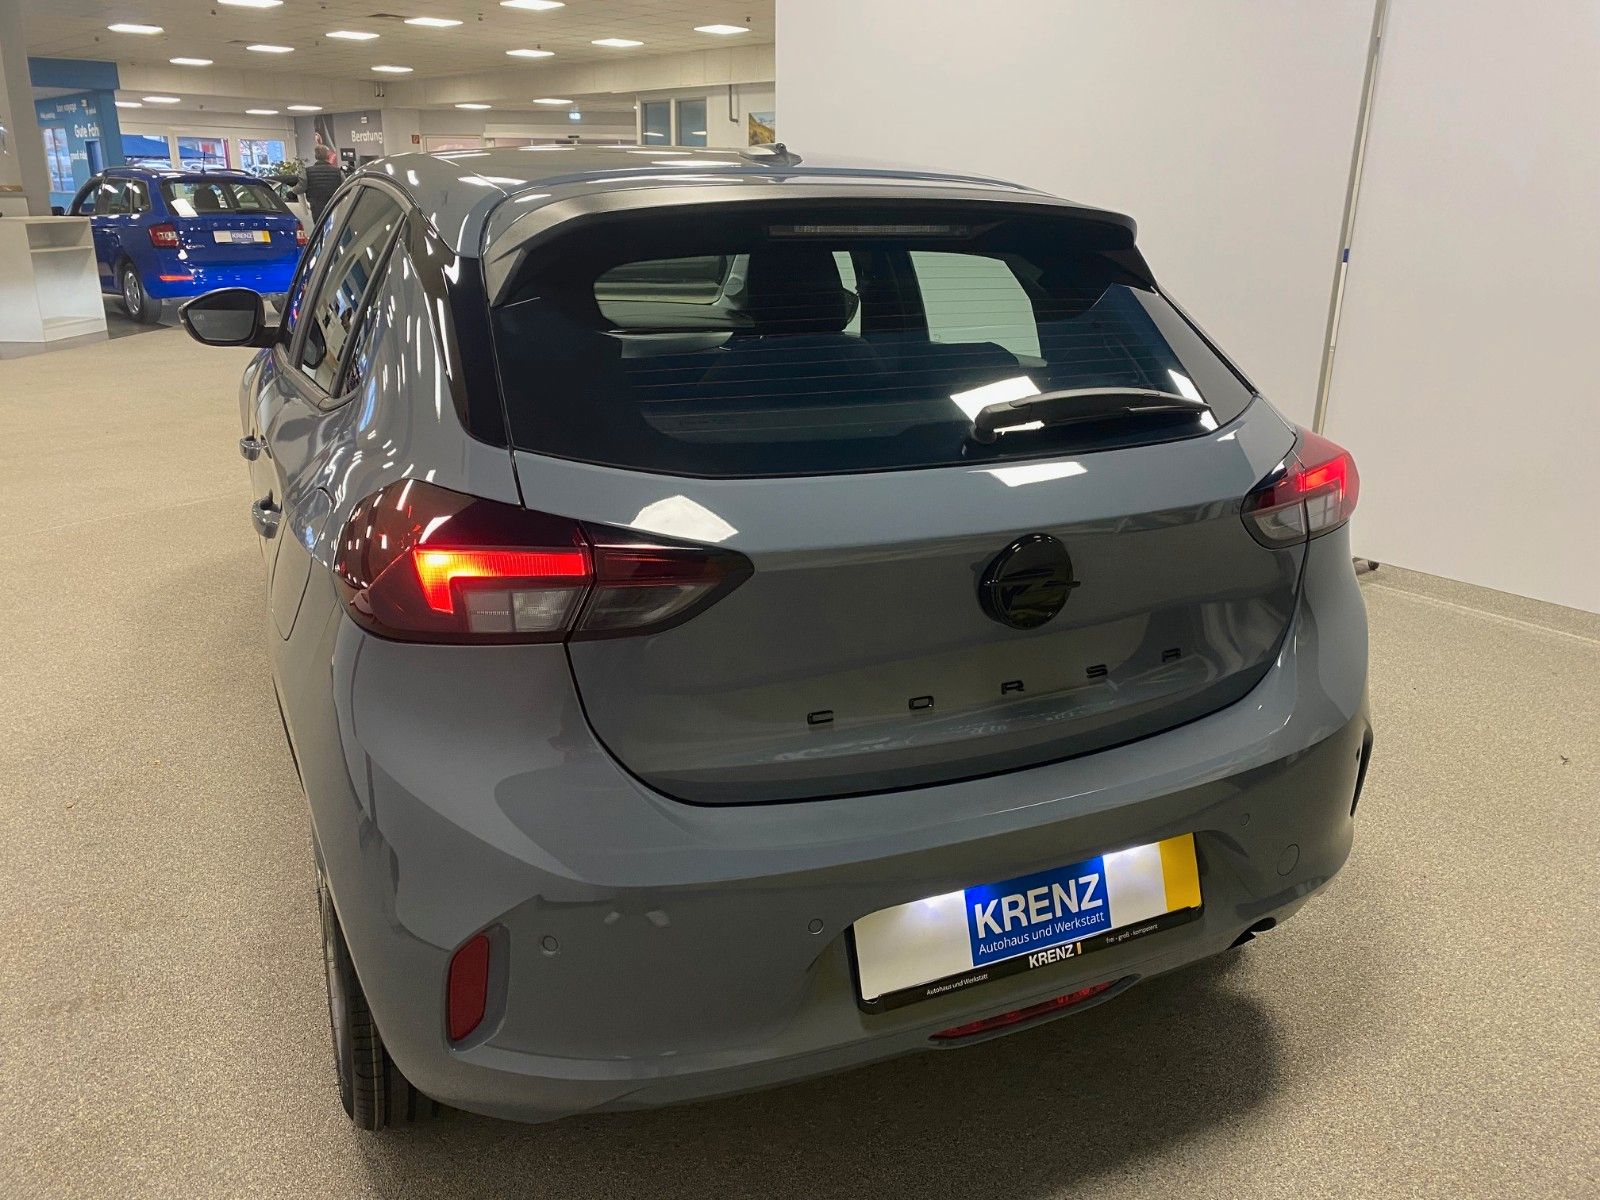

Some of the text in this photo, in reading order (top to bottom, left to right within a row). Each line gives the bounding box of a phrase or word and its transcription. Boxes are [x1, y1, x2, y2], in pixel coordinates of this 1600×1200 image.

[74, 124, 88, 138] Gute
[351, 130, 383, 144] Beratung
[806, 647, 1182, 727] CORSA
[974, 872, 1103, 939] KRENZ
[978, 911, 1105, 955] Autohaus und Werkstatt
[1132, 923, 1158, 936] kompetent
[1028, 944, 1075, 969] KRENZ
[926, 973, 989, 996] Autohaus und Werkstatt
